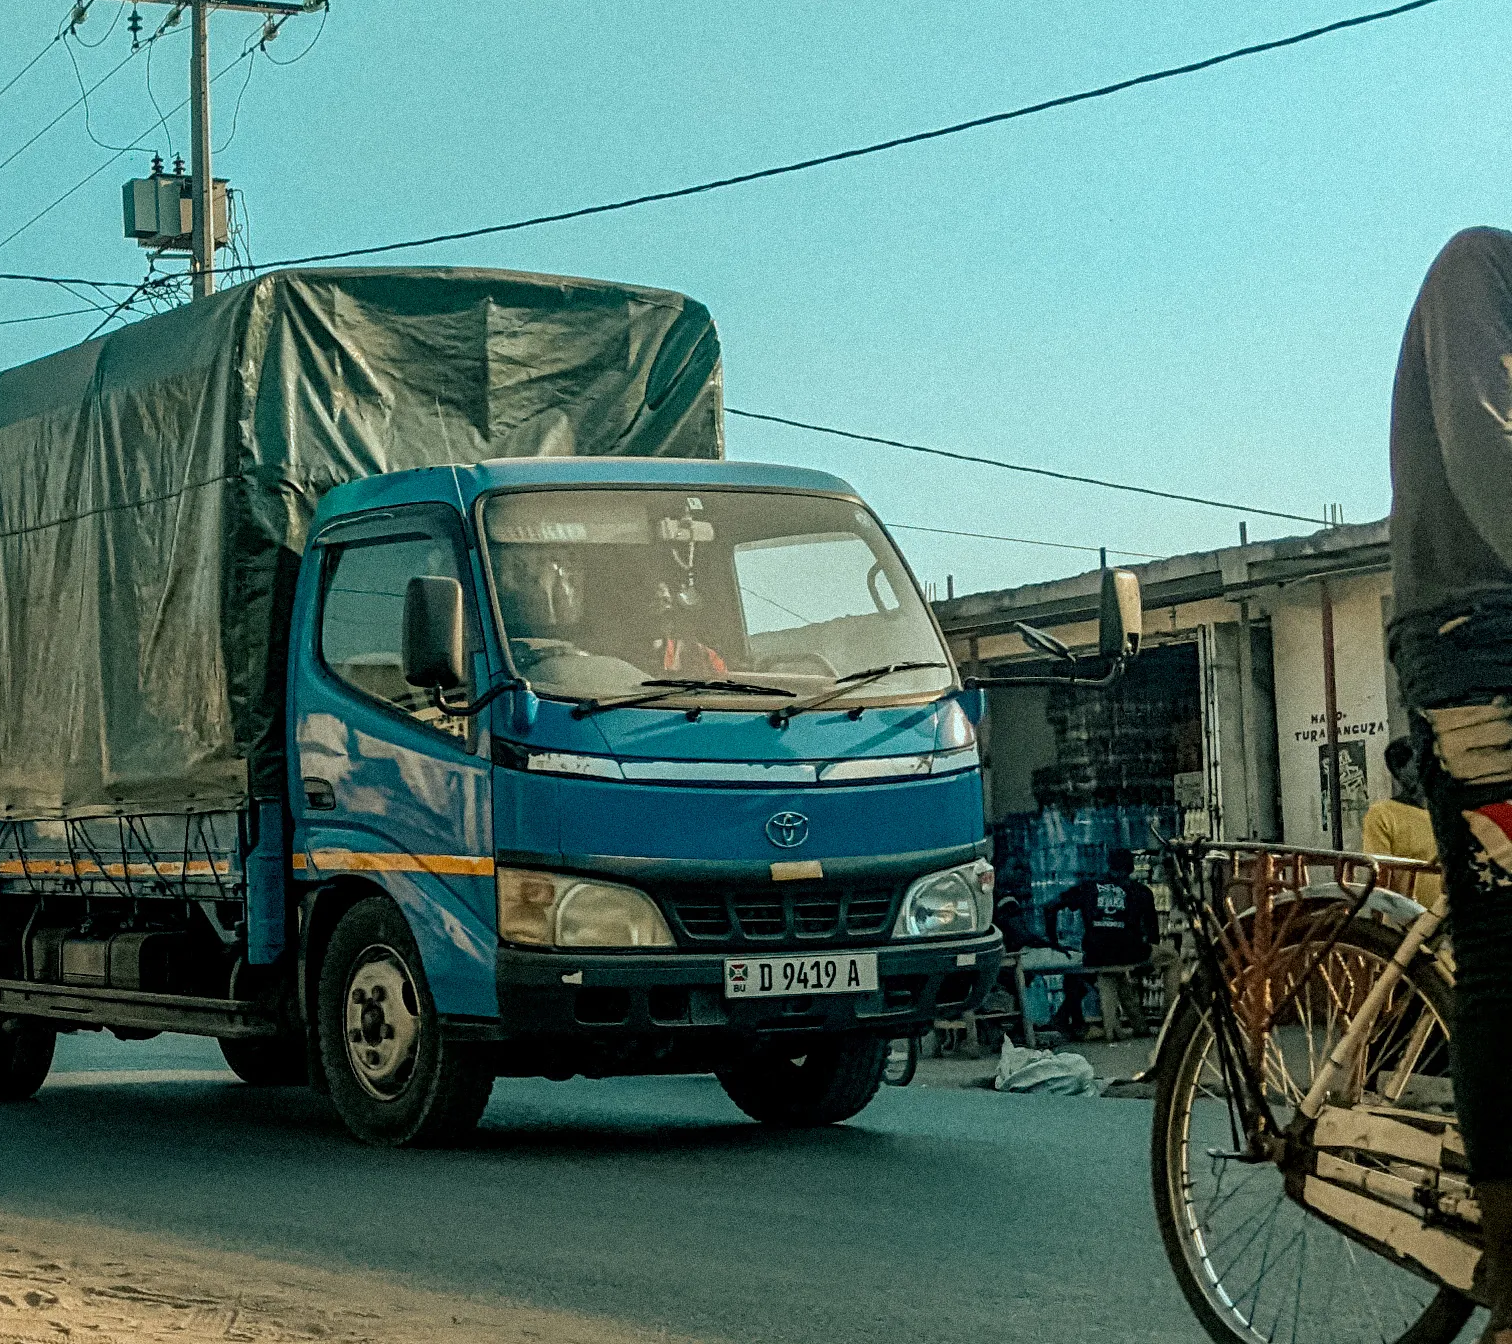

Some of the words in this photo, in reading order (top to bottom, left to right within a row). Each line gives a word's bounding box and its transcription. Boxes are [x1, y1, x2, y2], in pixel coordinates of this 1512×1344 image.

[1294, 721, 1384, 742] TURAANGUZA
[759, 963, 773, 992] D
[783, 960, 837, 991] 9419
[847, 959, 861, 988] A
[733, 984, 746, 993] BU
